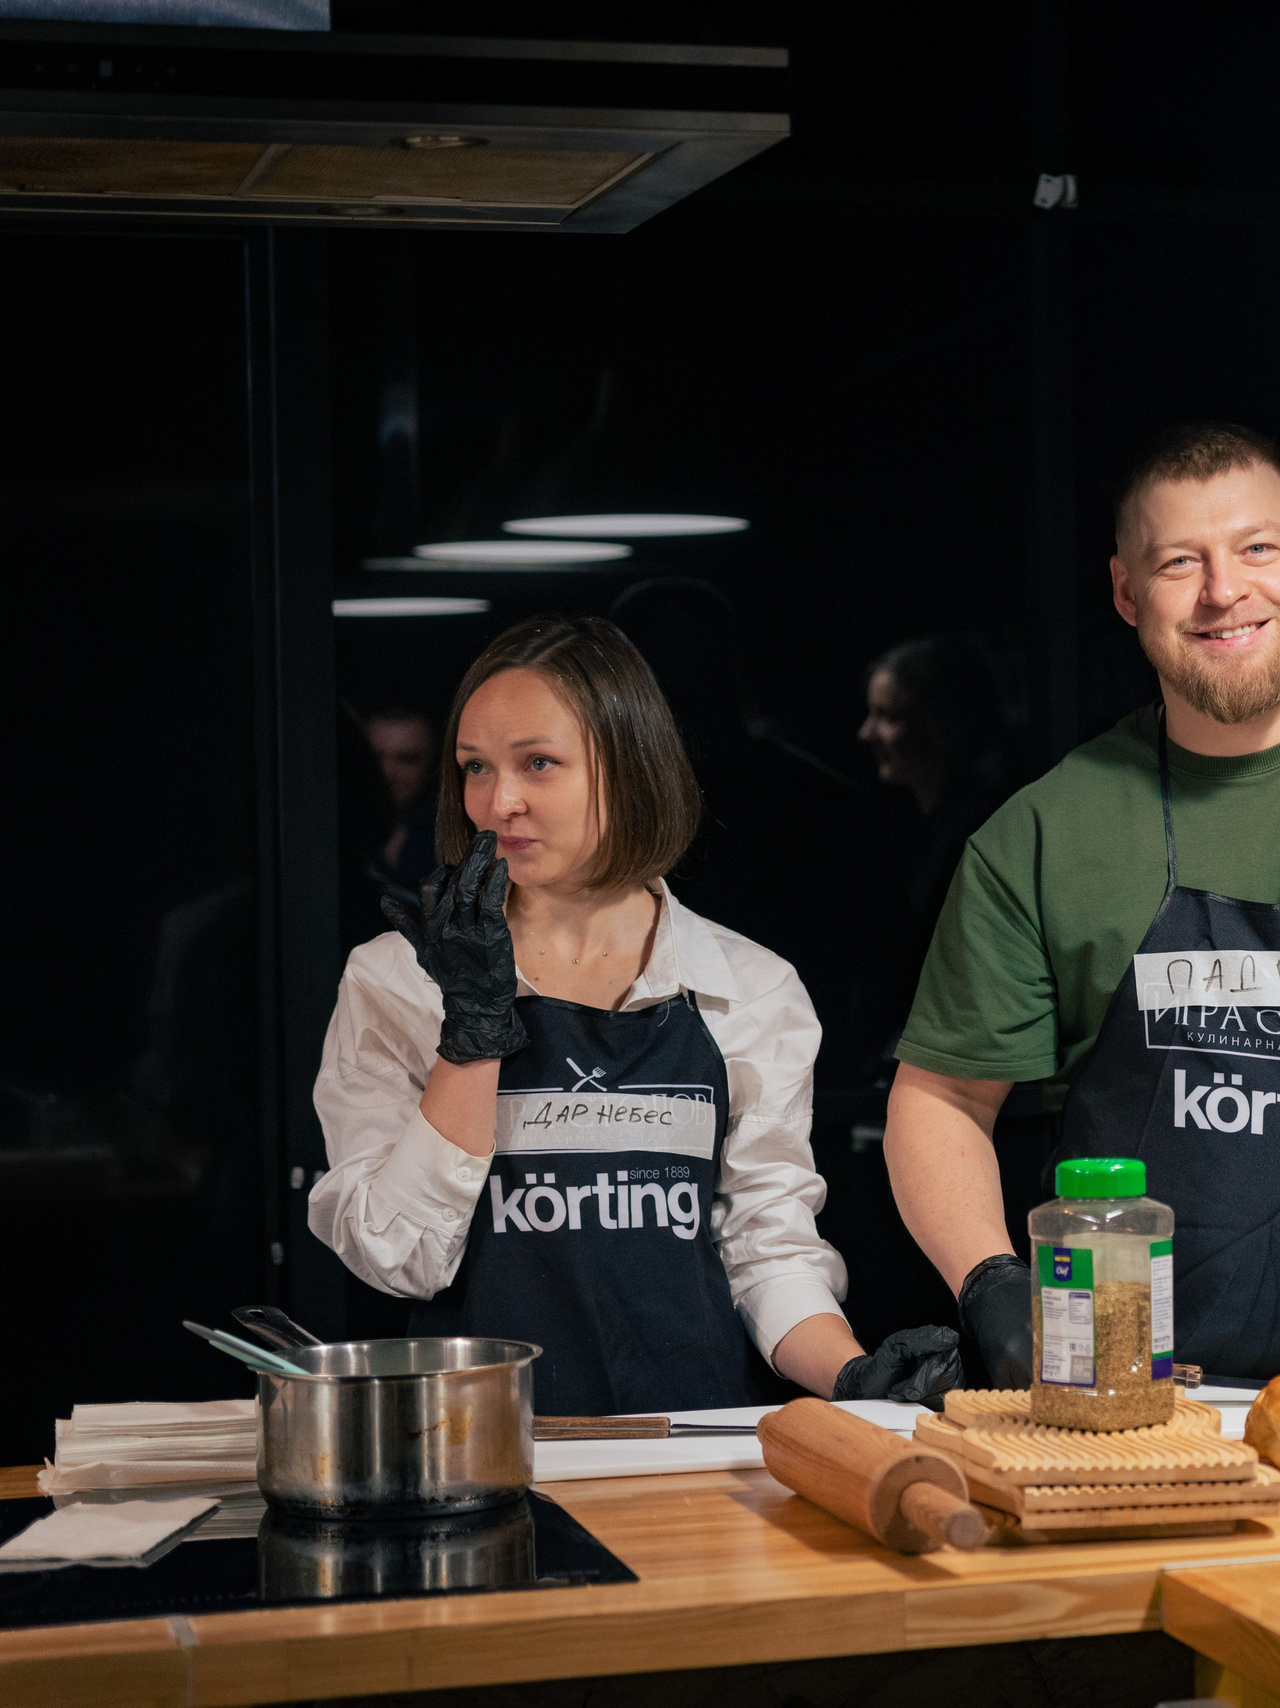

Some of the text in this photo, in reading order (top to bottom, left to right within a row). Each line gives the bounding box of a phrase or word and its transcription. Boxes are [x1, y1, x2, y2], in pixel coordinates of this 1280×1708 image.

[522, 1101, 589, 1130] ДАР
[629, 1165, 691, 1180] since 1889
[489, 1170, 700, 1240] körting
